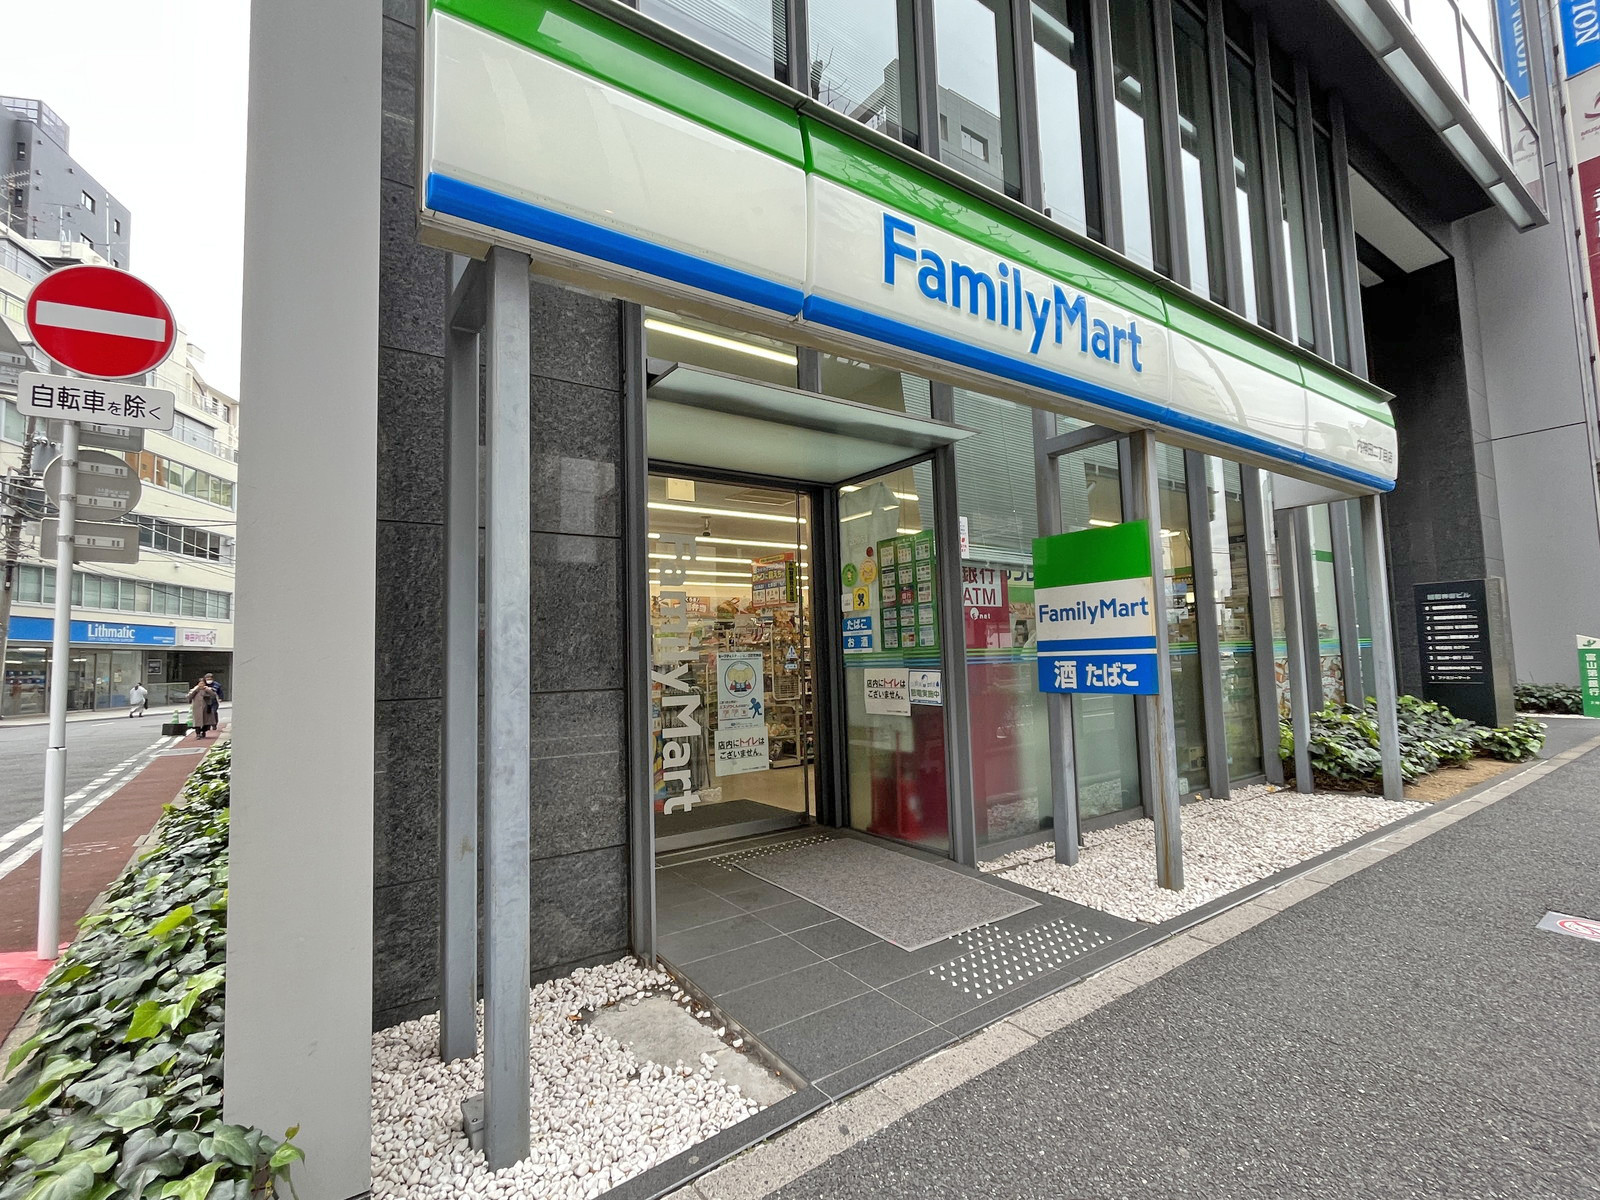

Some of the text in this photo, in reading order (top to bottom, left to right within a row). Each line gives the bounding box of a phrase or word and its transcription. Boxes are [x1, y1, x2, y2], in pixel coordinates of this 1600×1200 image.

[882, 211, 1143, 374] FamilyMart
[31, 384, 161, 420] 自転車を除く
[963, 587, 996, 605] ATM
[1038, 596, 1150, 625] FamilyMart
[87, 623, 136, 639] Lithmatic
[847, 618, 868, 630] たばこ
[1053, 660, 1140, 689] 酒 たばこ
[867, 678, 906, 688] 店内にトイレは
[868, 690, 904, 700] ございません。
[718, 737, 765, 749] 店内にトイレは
[720, 748, 763, 759] ございません。
